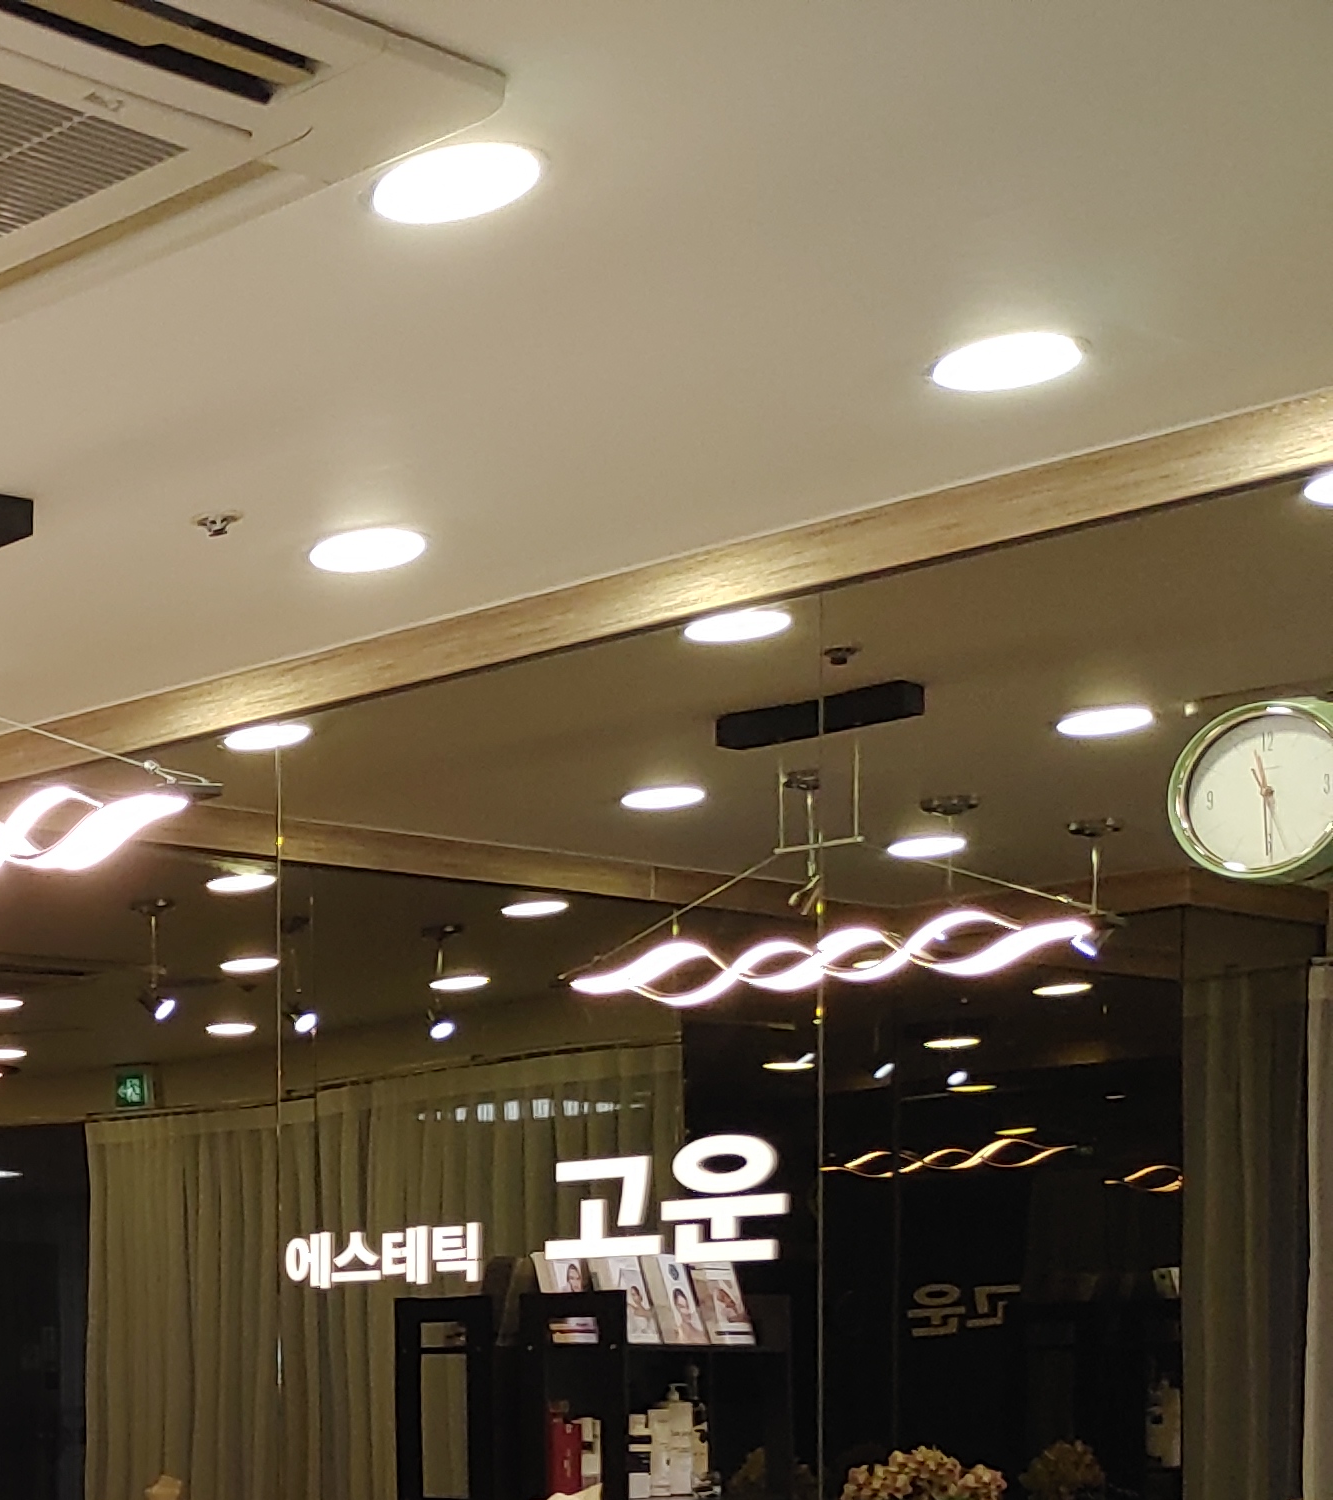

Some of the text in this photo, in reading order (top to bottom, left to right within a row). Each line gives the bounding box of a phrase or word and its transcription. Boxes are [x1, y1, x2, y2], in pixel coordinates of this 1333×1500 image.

[1261, 732, 1274, 752] 12
[1323, 773, 1331, 794] 3
[1206, 791, 1214, 810] 9
[286, 1133, 792, 1290] 에스테틱 고운
